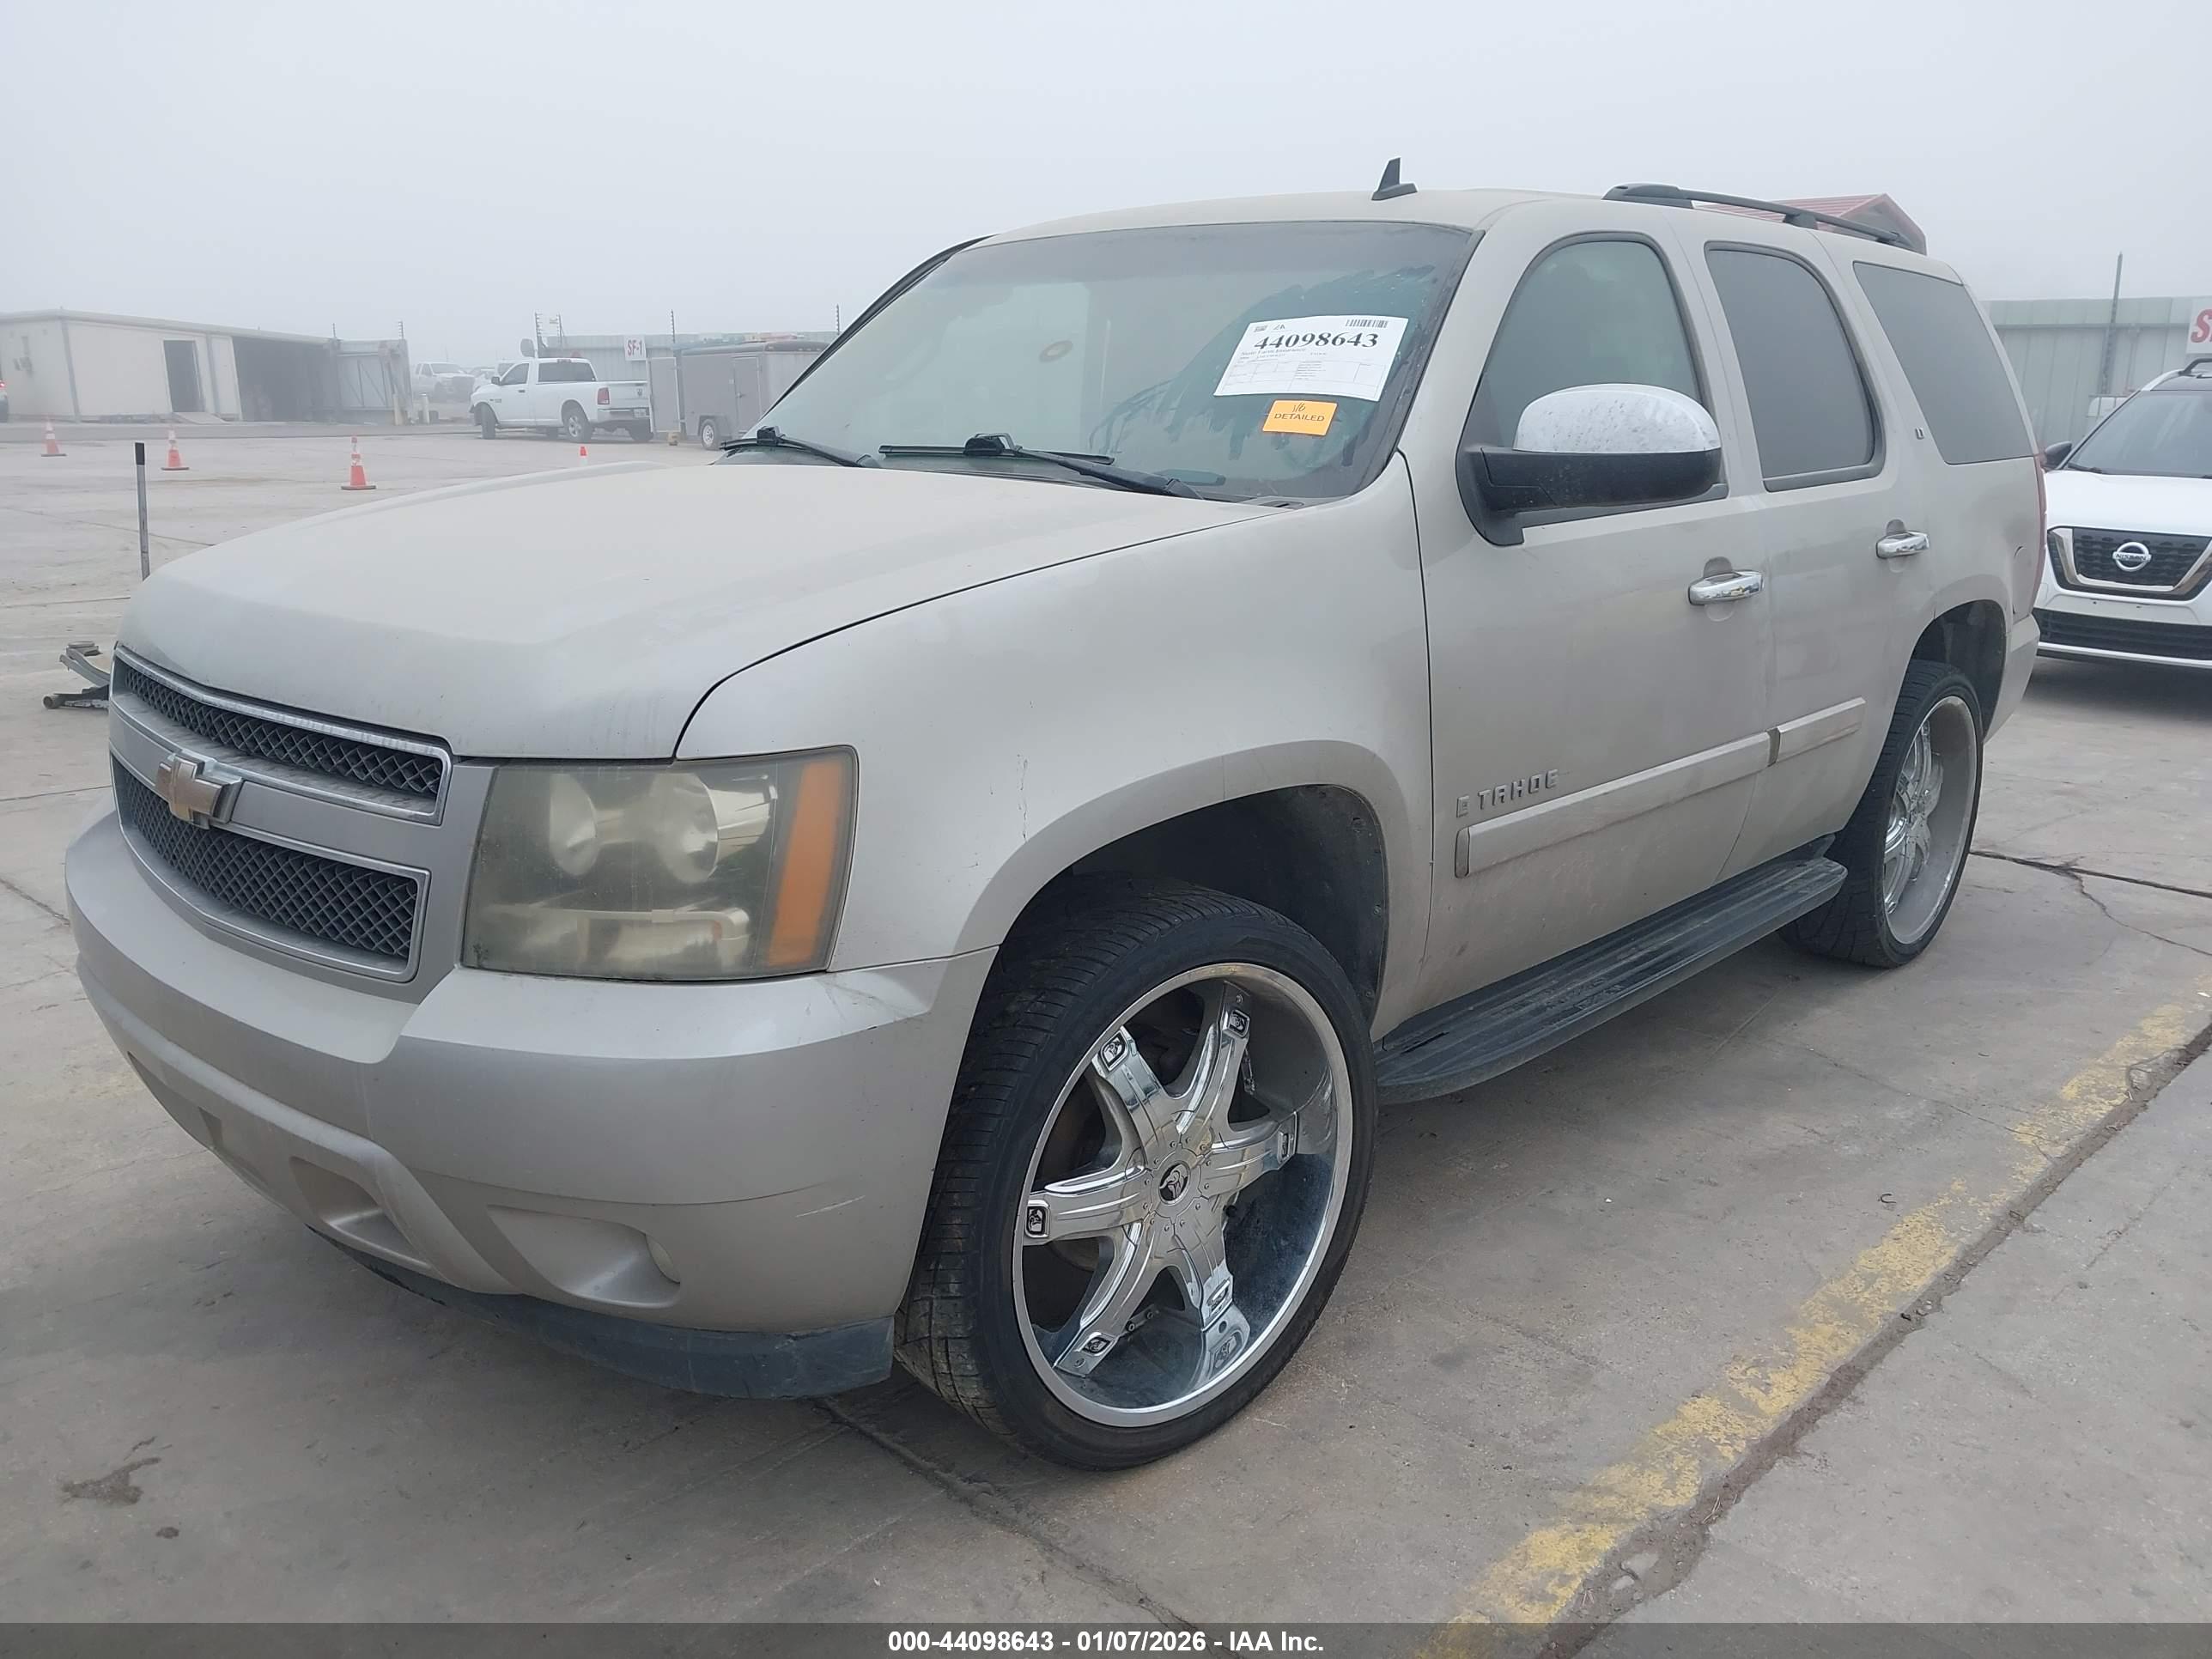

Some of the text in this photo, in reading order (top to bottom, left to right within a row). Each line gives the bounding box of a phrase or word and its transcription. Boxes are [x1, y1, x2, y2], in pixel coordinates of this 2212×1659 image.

[2191, 309, 2212, 343] S
[627, 339, 643, 356] SF-1
[1255, 332, 1378, 349] 44098643
[1477, 769, 1559, 810] TAHOE
